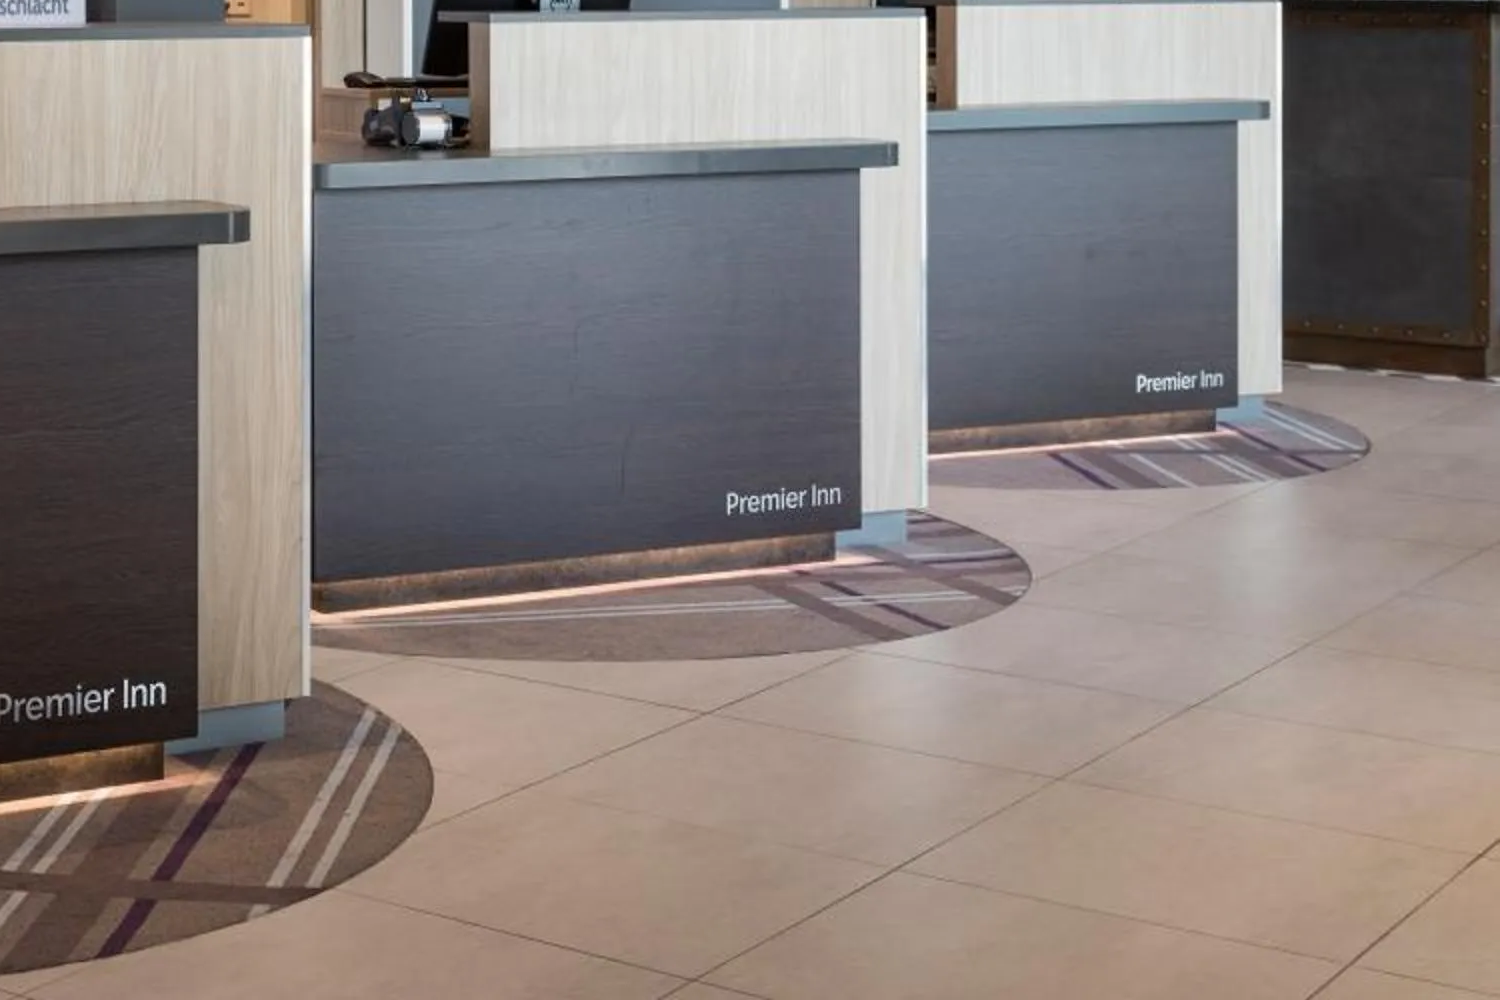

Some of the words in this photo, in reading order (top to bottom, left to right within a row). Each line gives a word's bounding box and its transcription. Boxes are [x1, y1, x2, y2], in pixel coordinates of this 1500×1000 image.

[1136, 371, 1199, 393] Premier
[1200, 369, 1225, 389] Inn
[726, 487, 808, 516] Premier
[811, 483, 842, 508] Inn
[123, 677, 168, 710] Inn
